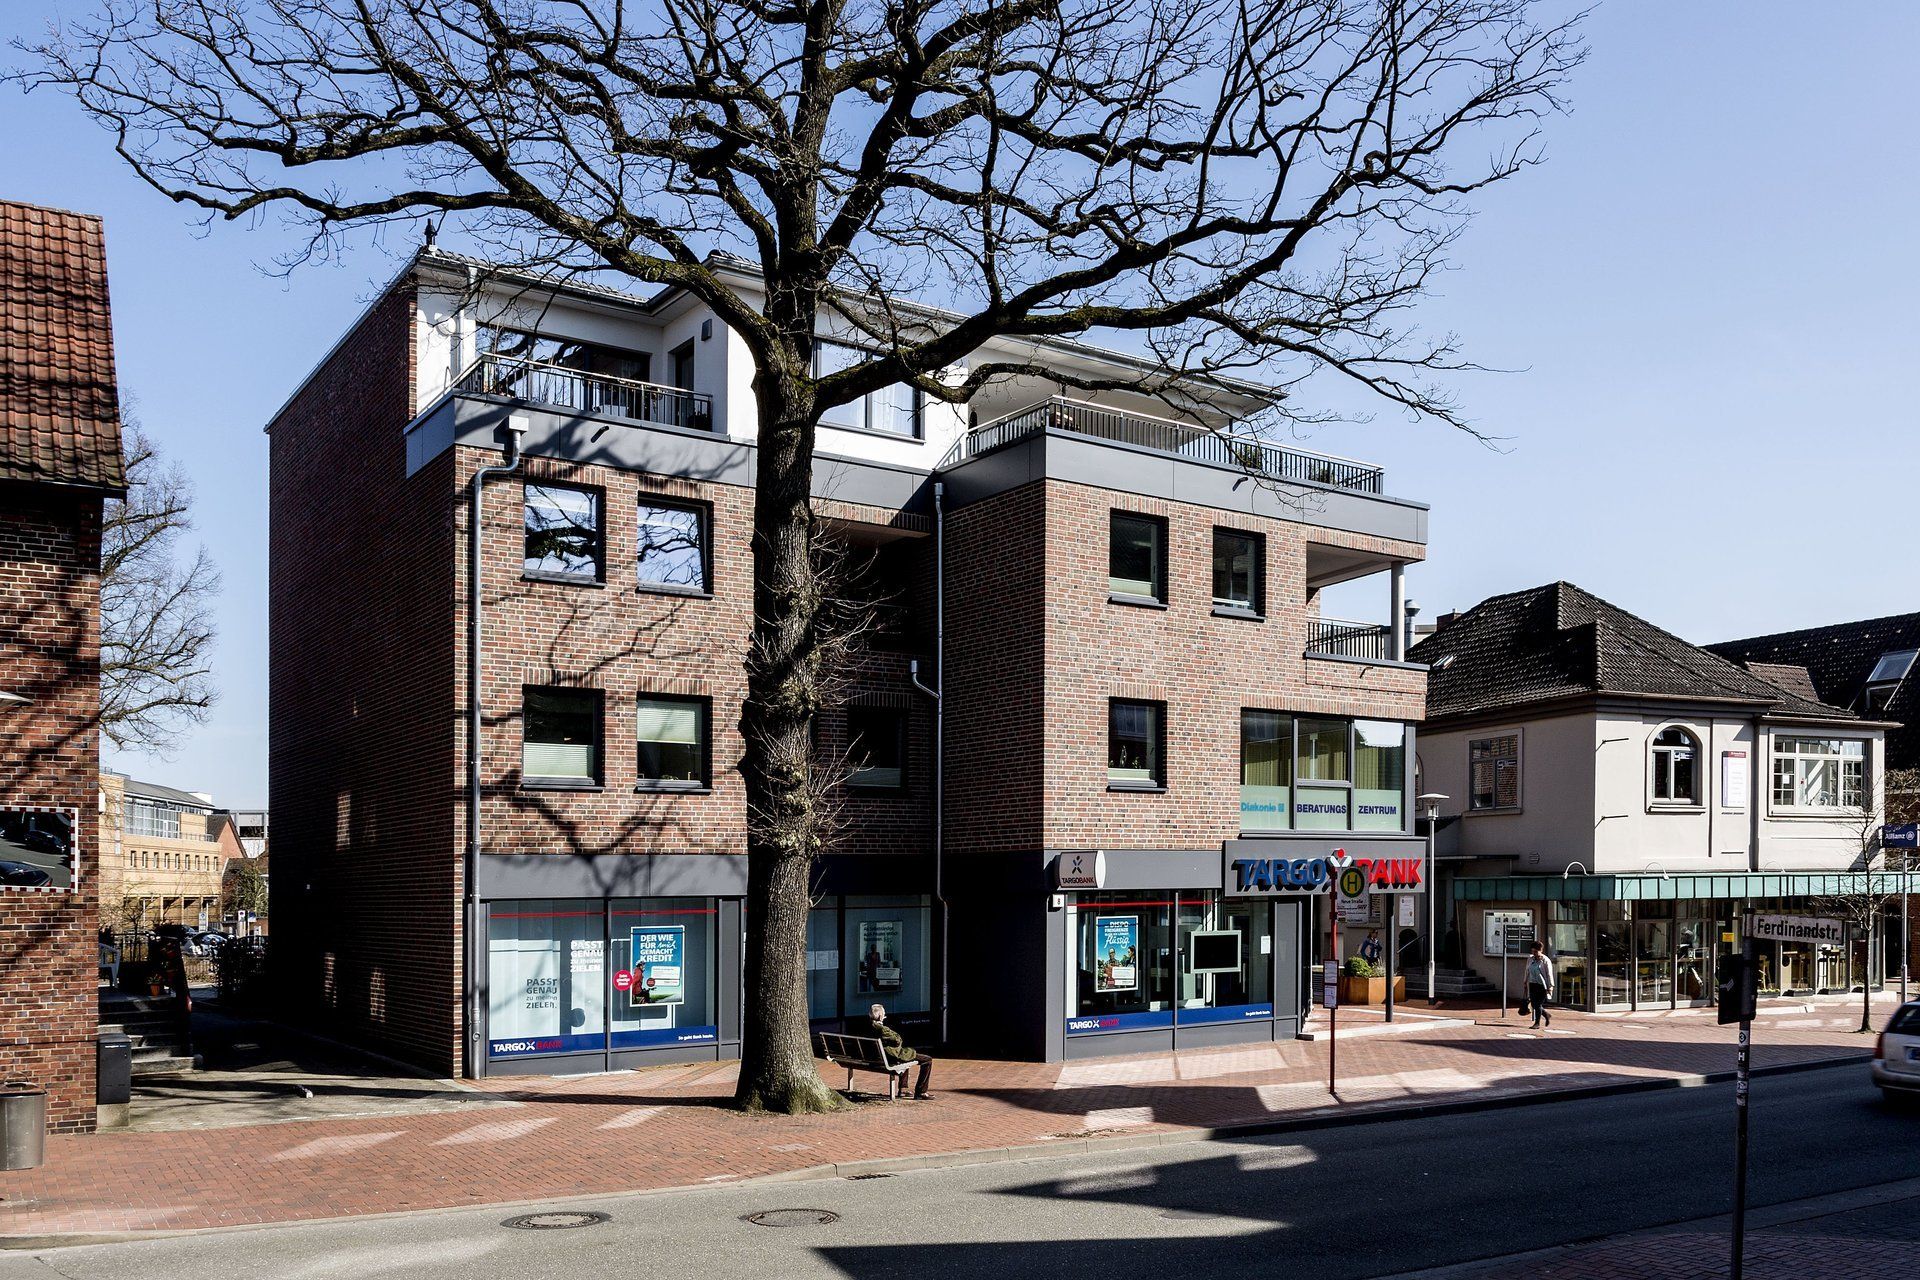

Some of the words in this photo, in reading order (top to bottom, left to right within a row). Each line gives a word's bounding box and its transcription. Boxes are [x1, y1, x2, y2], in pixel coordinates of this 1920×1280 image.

[1240, 802, 1277, 812] Diakonie
[1296, 803, 1347, 814] BERATUNGS
[1358, 805, 1397, 815] ZENTRUM
[1238, 858, 1327, 886] TARGO
[1061, 876, 1095, 884] TARGOBANK
[1757, 918, 1840, 941] Ferdinandstr.
[640, 934, 657, 942] DER
[658, 934, 674, 942] WIE
[640, 941, 657, 949] FÜR
[640, 948, 674, 956] GEMACHT
[640, 955, 674, 963] KREDIT
[526, 978, 558, 986] PASST
[526, 987, 558, 995] GENAU
[1068, 1020, 1093, 1030] TARGO
[492, 1042, 526, 1053] TARGO
[536, 1040, 564, 1050] BANK
